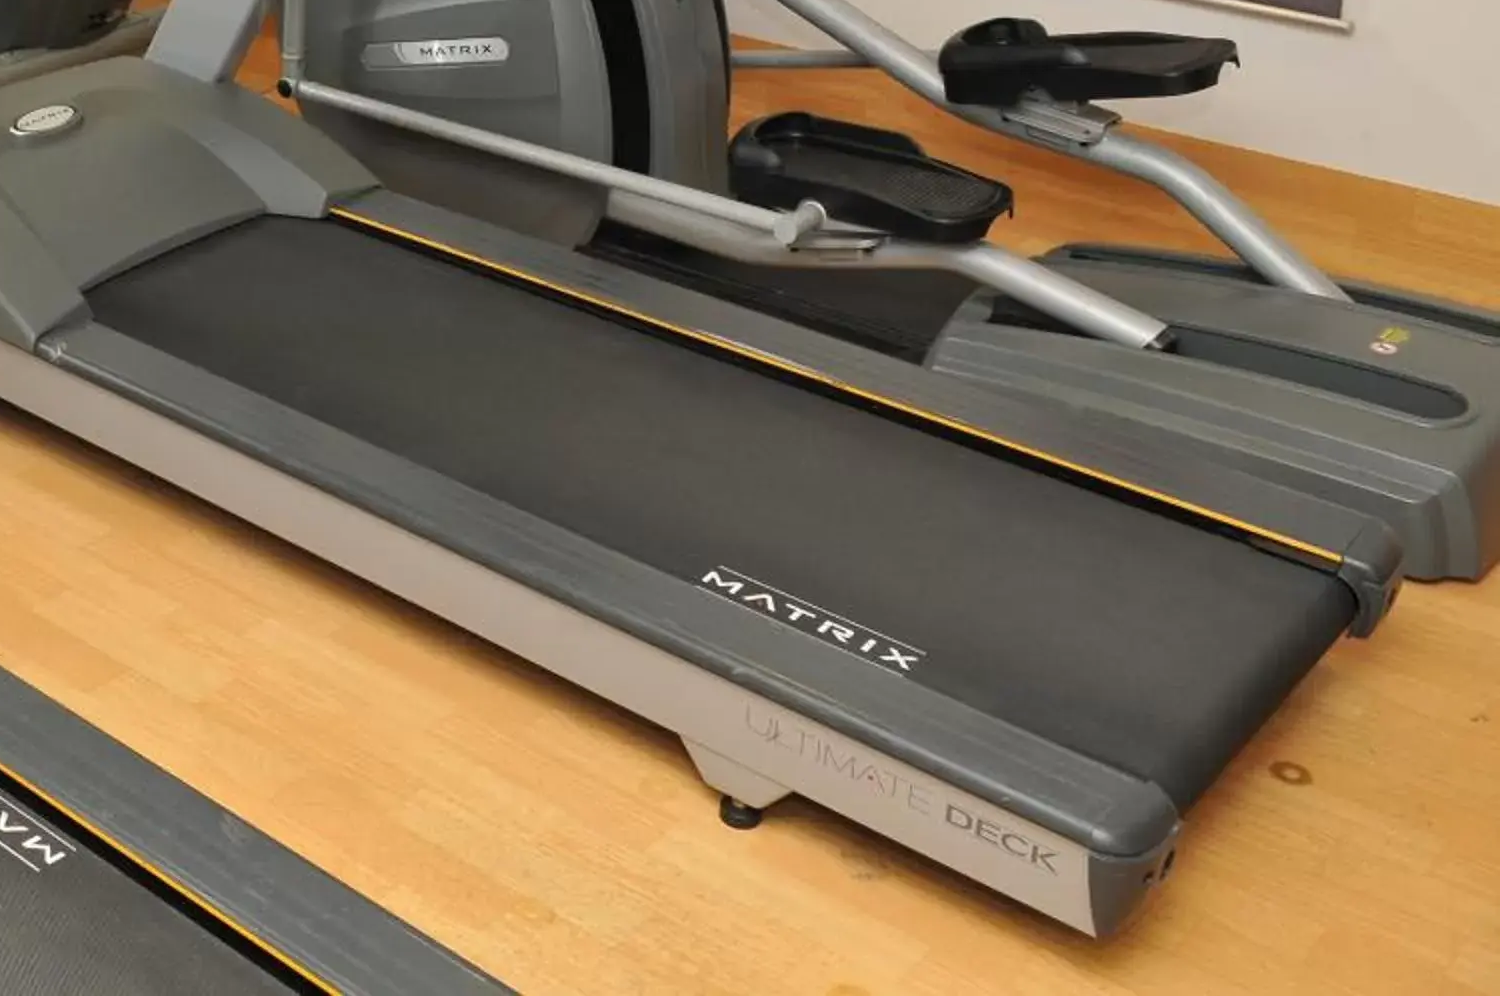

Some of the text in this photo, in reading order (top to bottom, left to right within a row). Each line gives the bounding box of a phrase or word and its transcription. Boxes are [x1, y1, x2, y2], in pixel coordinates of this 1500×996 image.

[419, 43, 493, 57] MATRIX
[701, 570, 920, 671] MATRIX
[742, 700, 1059, 876] ULTIMATE DECK
